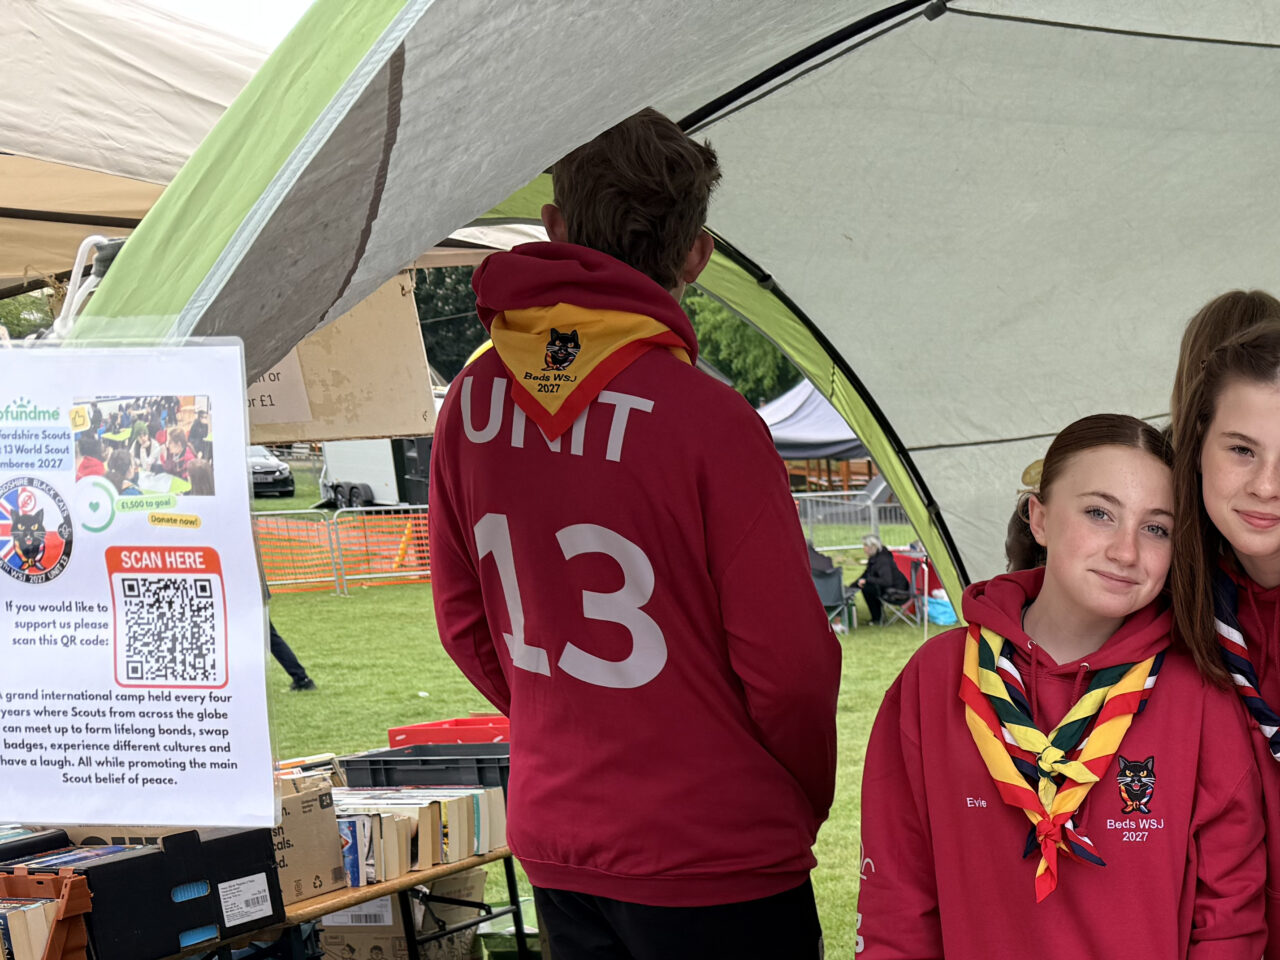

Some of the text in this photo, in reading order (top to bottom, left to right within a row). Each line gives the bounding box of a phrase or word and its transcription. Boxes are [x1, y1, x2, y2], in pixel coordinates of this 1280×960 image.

[268, 372, 281, 382] or
[524, 371, 577, 382] Beds WSJ
[537, 383, 560, 393] 2027
[260, 394, 275, 407] £1
[0, 430, 71, 440] ordshire Scouts
[4, 444, 69, 454] 13 World Scout
[37, 458, 63, 469] 2027
[121, 497, 171, 510] £1,500 to goal
[150, 515, 198, 526] Donate now!
[121, 551, 205, 569] SCAN HERE
[473, 512, 668, 689] 13
[5, 602, 108, 615] If you would like to
[14, 619, 109, 631] support us please
[12, 635, 109, 648] scan this QR code:
[5, 689, 38, 703] grand
[41, 689, 112, 701] international
[115, 692, 145, 704] camp
[148, 690, 171, 702] held
[174, 692, 205, 705] every
[208, 692, 232, 703] four
[1, 706, 228, 722] years where Scouts from across the globe
[2, 723, 229, 739] can meet up to form lifelong bonds, swap
[3, 738, 231, 753] badges, experience different cultures and
[0, 755, 27, 766] have
[40, 755, 74, 769] laugh.
[78, 756, 92, 767] All
[95, 756, 125, 767] while
[128, 758, 187, 770] promoting
[189, 757, 207, 768] the
[210, 759, 238, 769] main
[62, 772, 178, 787] Scout belief of peace.
[966, 796, 987, 809] Evie
[1106, 818, 1164, 829] Beds WSJ
[1122, 831, 1148, 841] 2027
